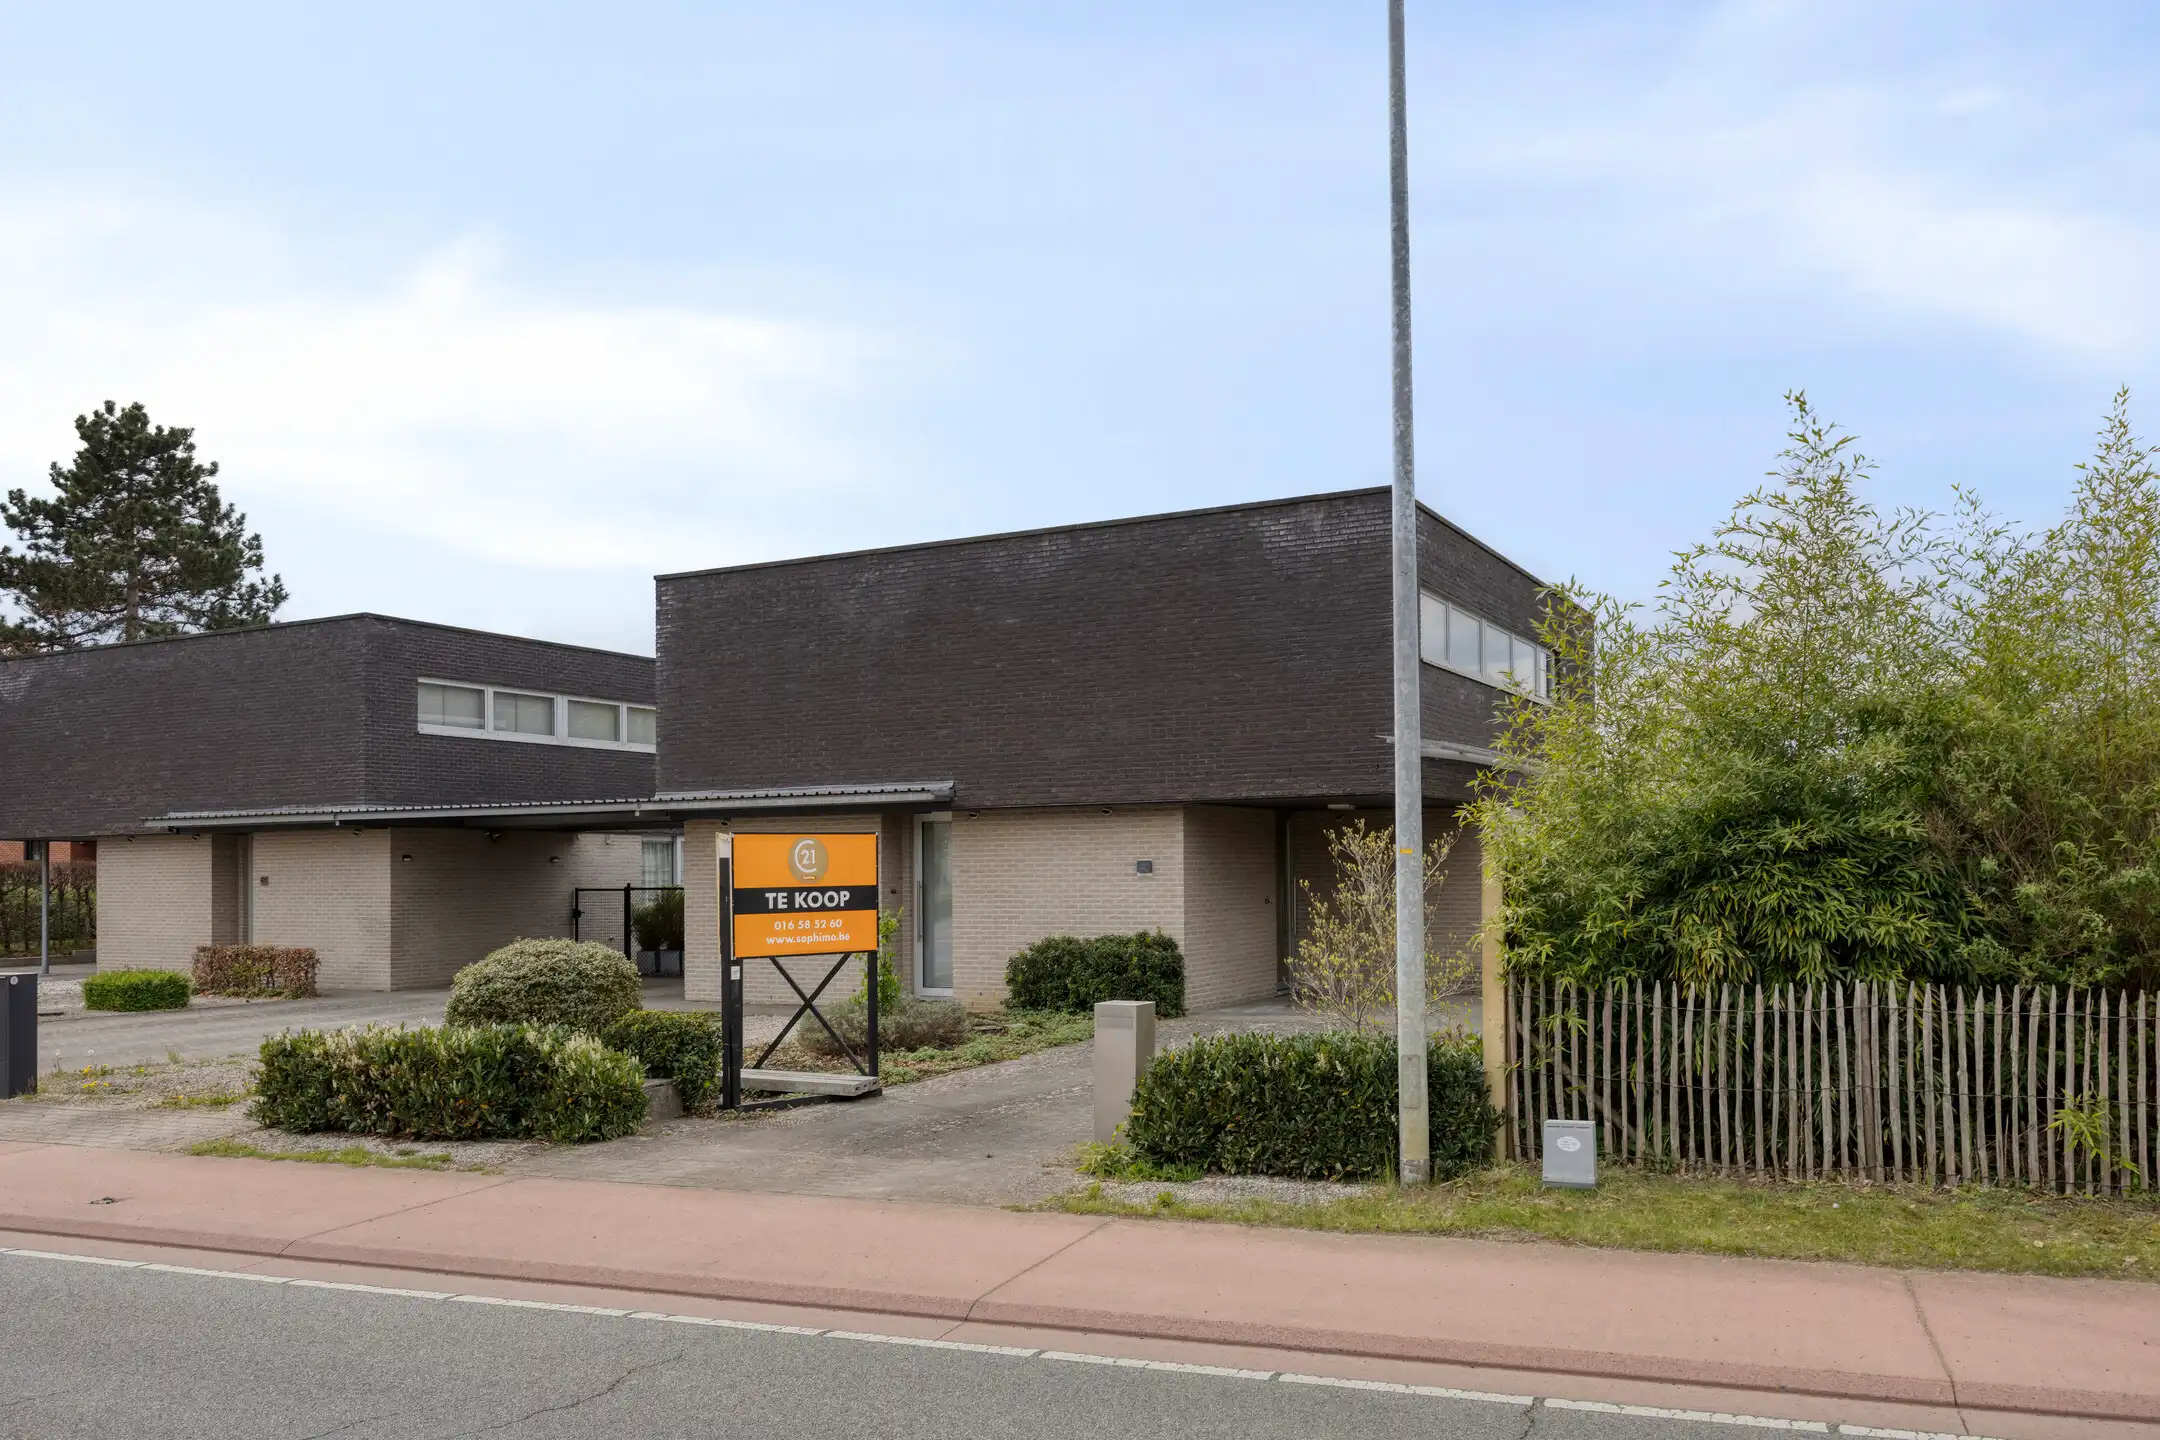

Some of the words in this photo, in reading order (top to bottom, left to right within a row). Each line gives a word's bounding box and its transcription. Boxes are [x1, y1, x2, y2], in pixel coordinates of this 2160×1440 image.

[765, 892, 788, 909] TE
[794, 890, 850, 909] KOOP
[774, 920, 795, 931] 016
[798, 919, 811, 930] 58
[814, 919, 827, 929] 52
[830, 918, 843, 928] 60
[766, 932, 850, 945] www.sophimo.be
